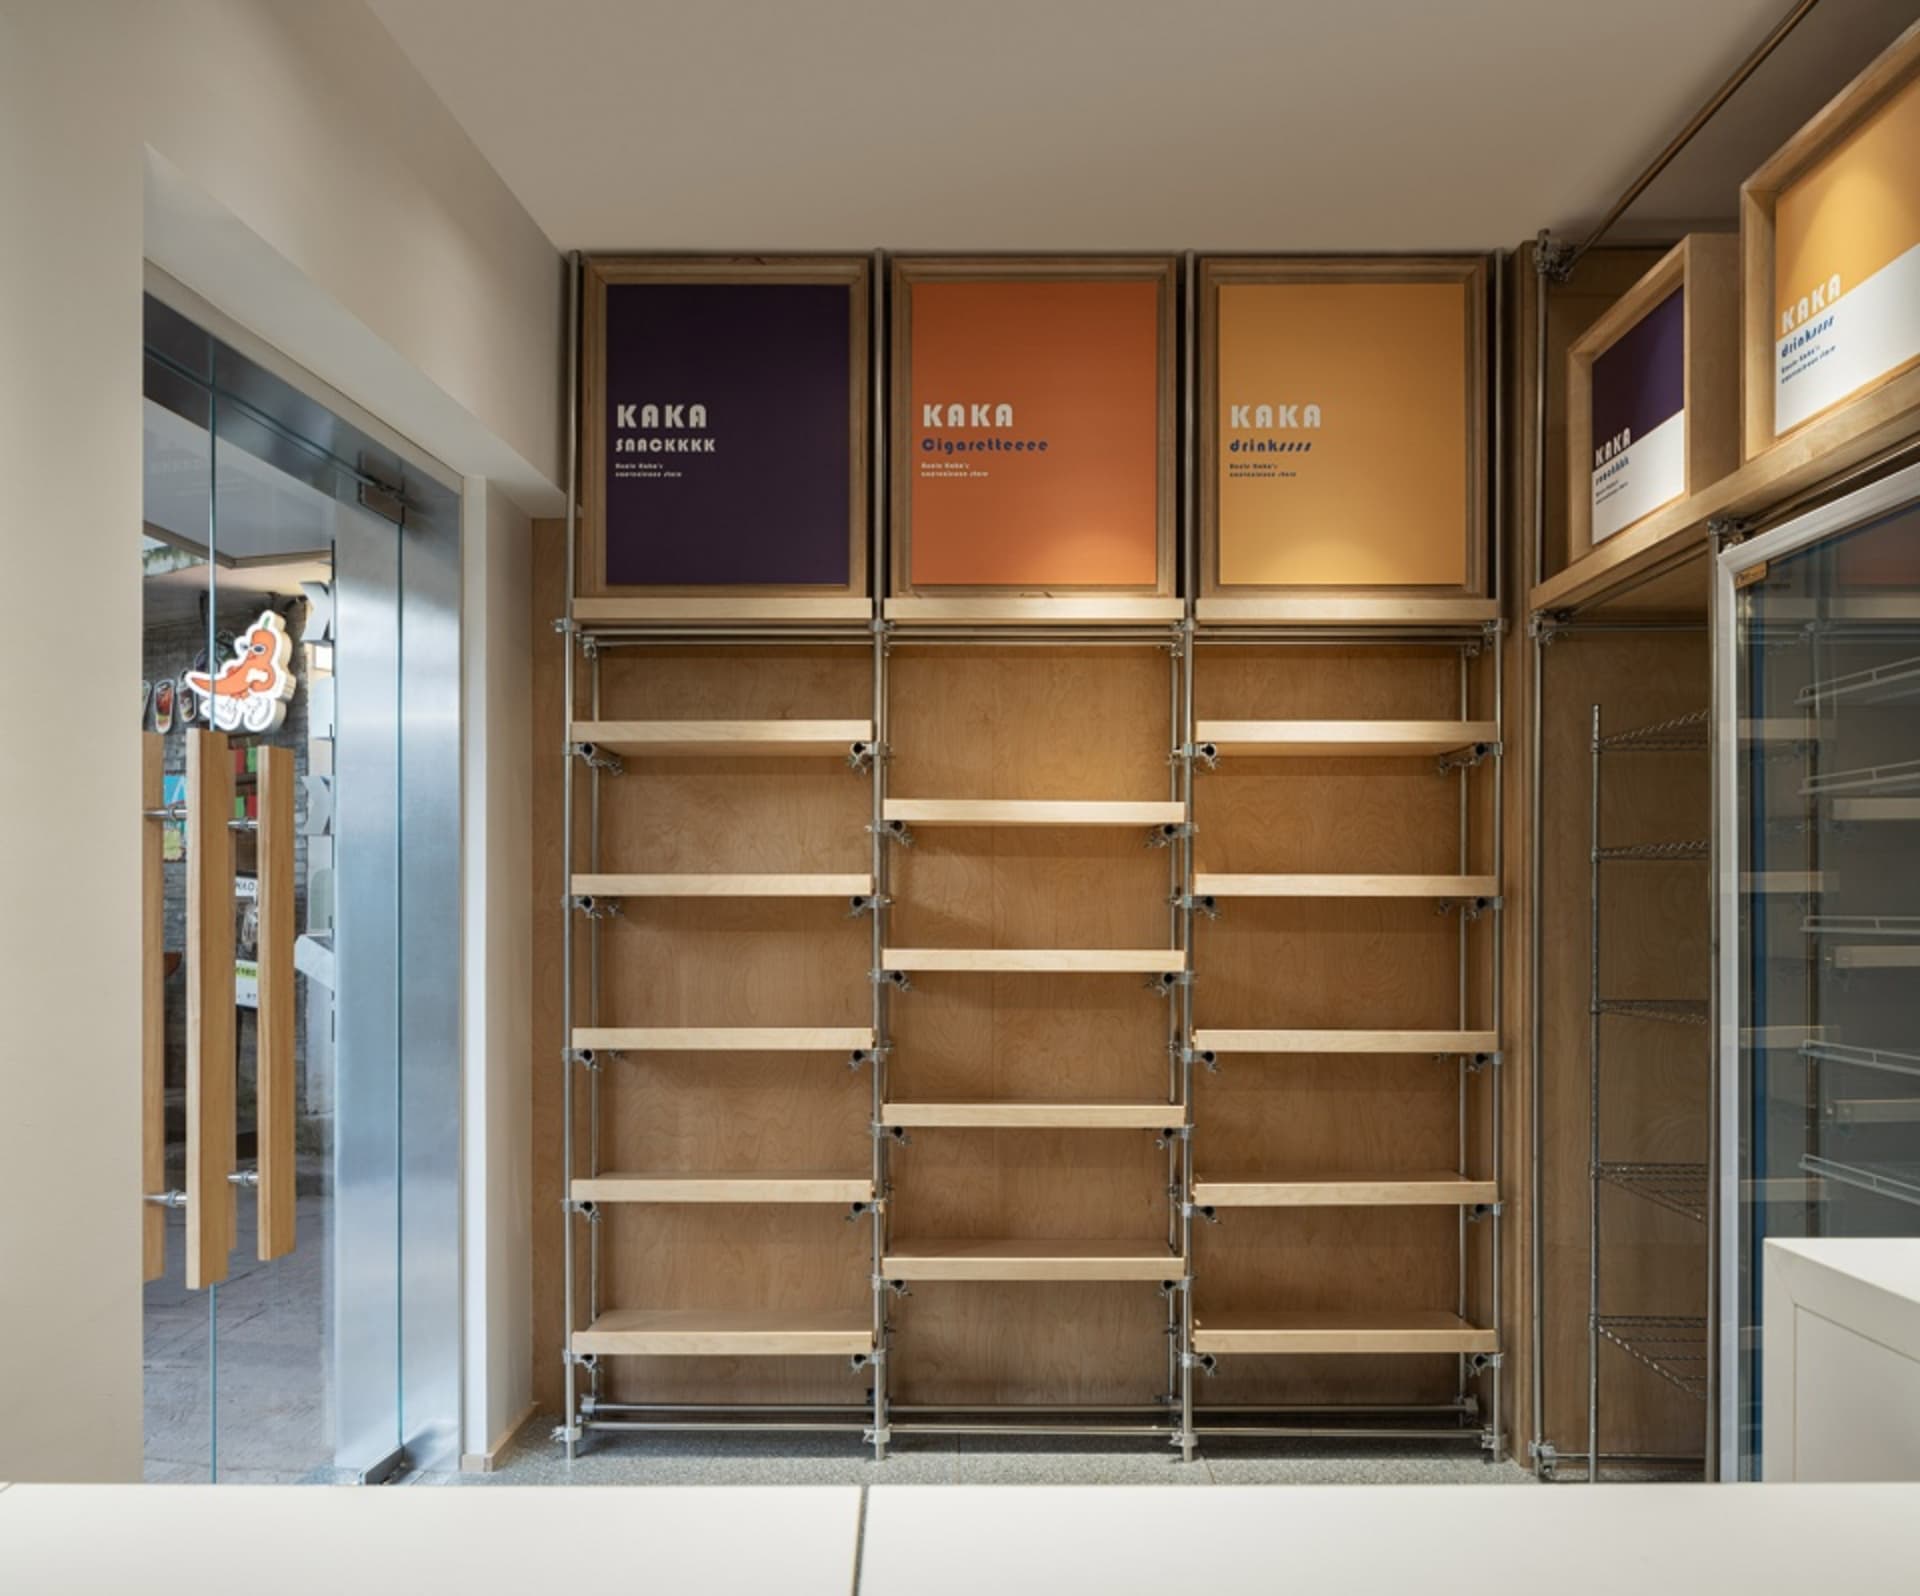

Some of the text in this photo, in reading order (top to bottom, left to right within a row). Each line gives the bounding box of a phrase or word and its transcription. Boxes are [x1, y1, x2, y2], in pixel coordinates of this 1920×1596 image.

[1782, 273, 1841, 333] KAKA
[617, 404, 707, 428] KAKA
[923, 403, 1013, 428] KAKA
[1231, 404, 1321, 428] KAKA
[921, 437, 1048, 455] Cigaretteeee
[1229, 438, 1312, 453] drinkssss
[1595, 427, 1631, 467] KAKA
